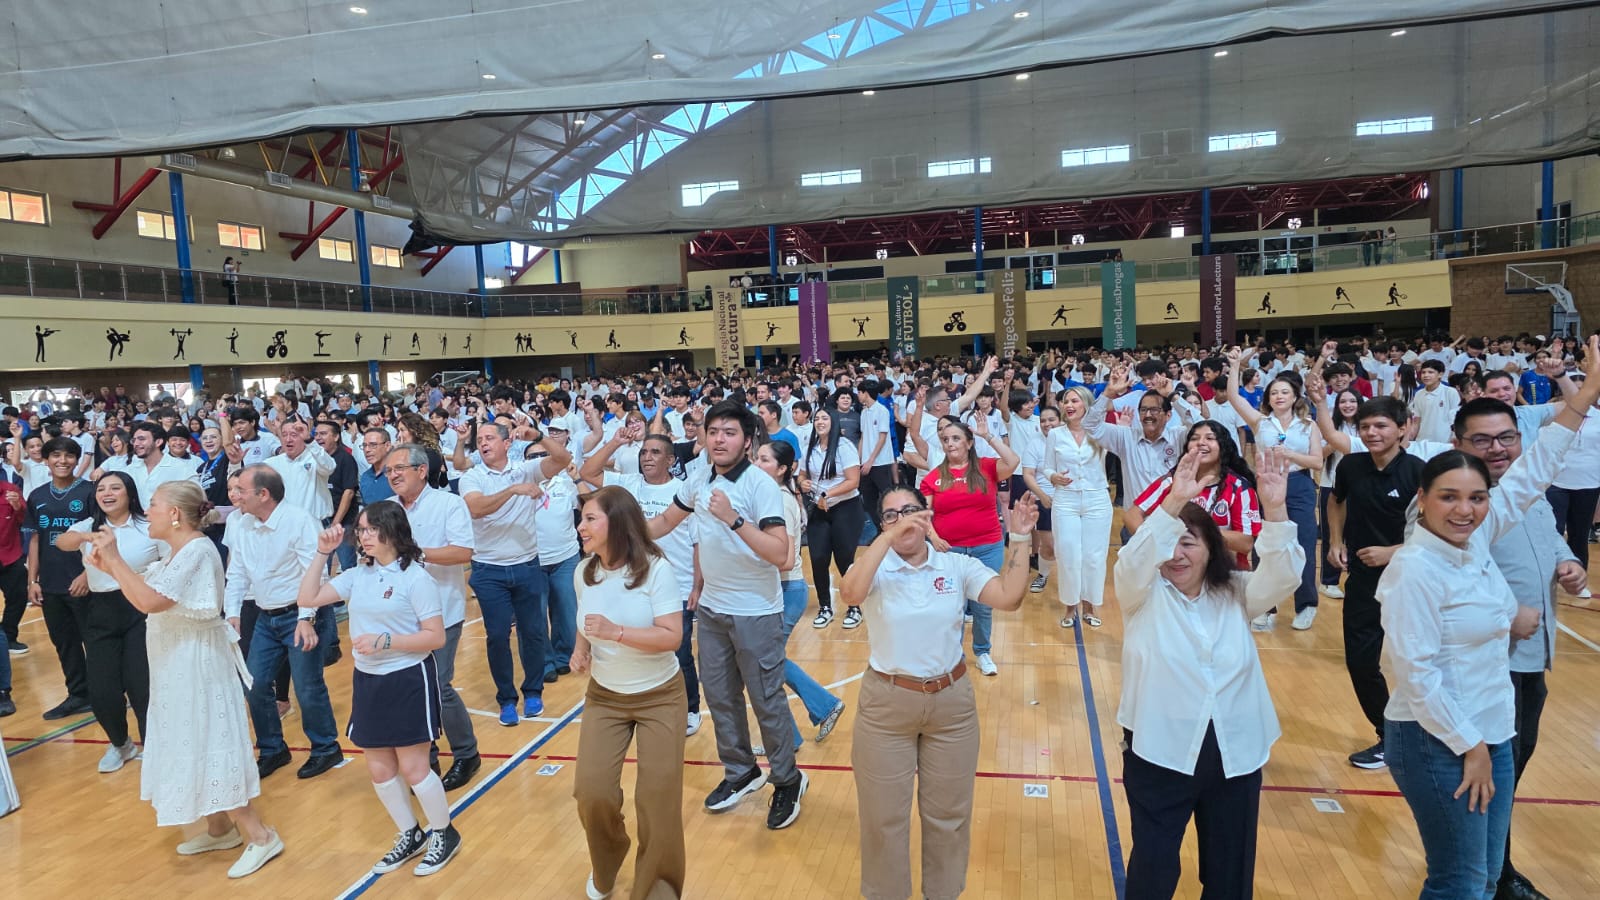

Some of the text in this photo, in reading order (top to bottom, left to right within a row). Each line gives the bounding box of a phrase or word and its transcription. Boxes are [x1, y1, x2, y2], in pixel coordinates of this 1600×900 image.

[727, 303, 739, 361] Lectura
[902, 292, 914, 341] FUTBOL
[52, 517, 78, 527] AT&T
